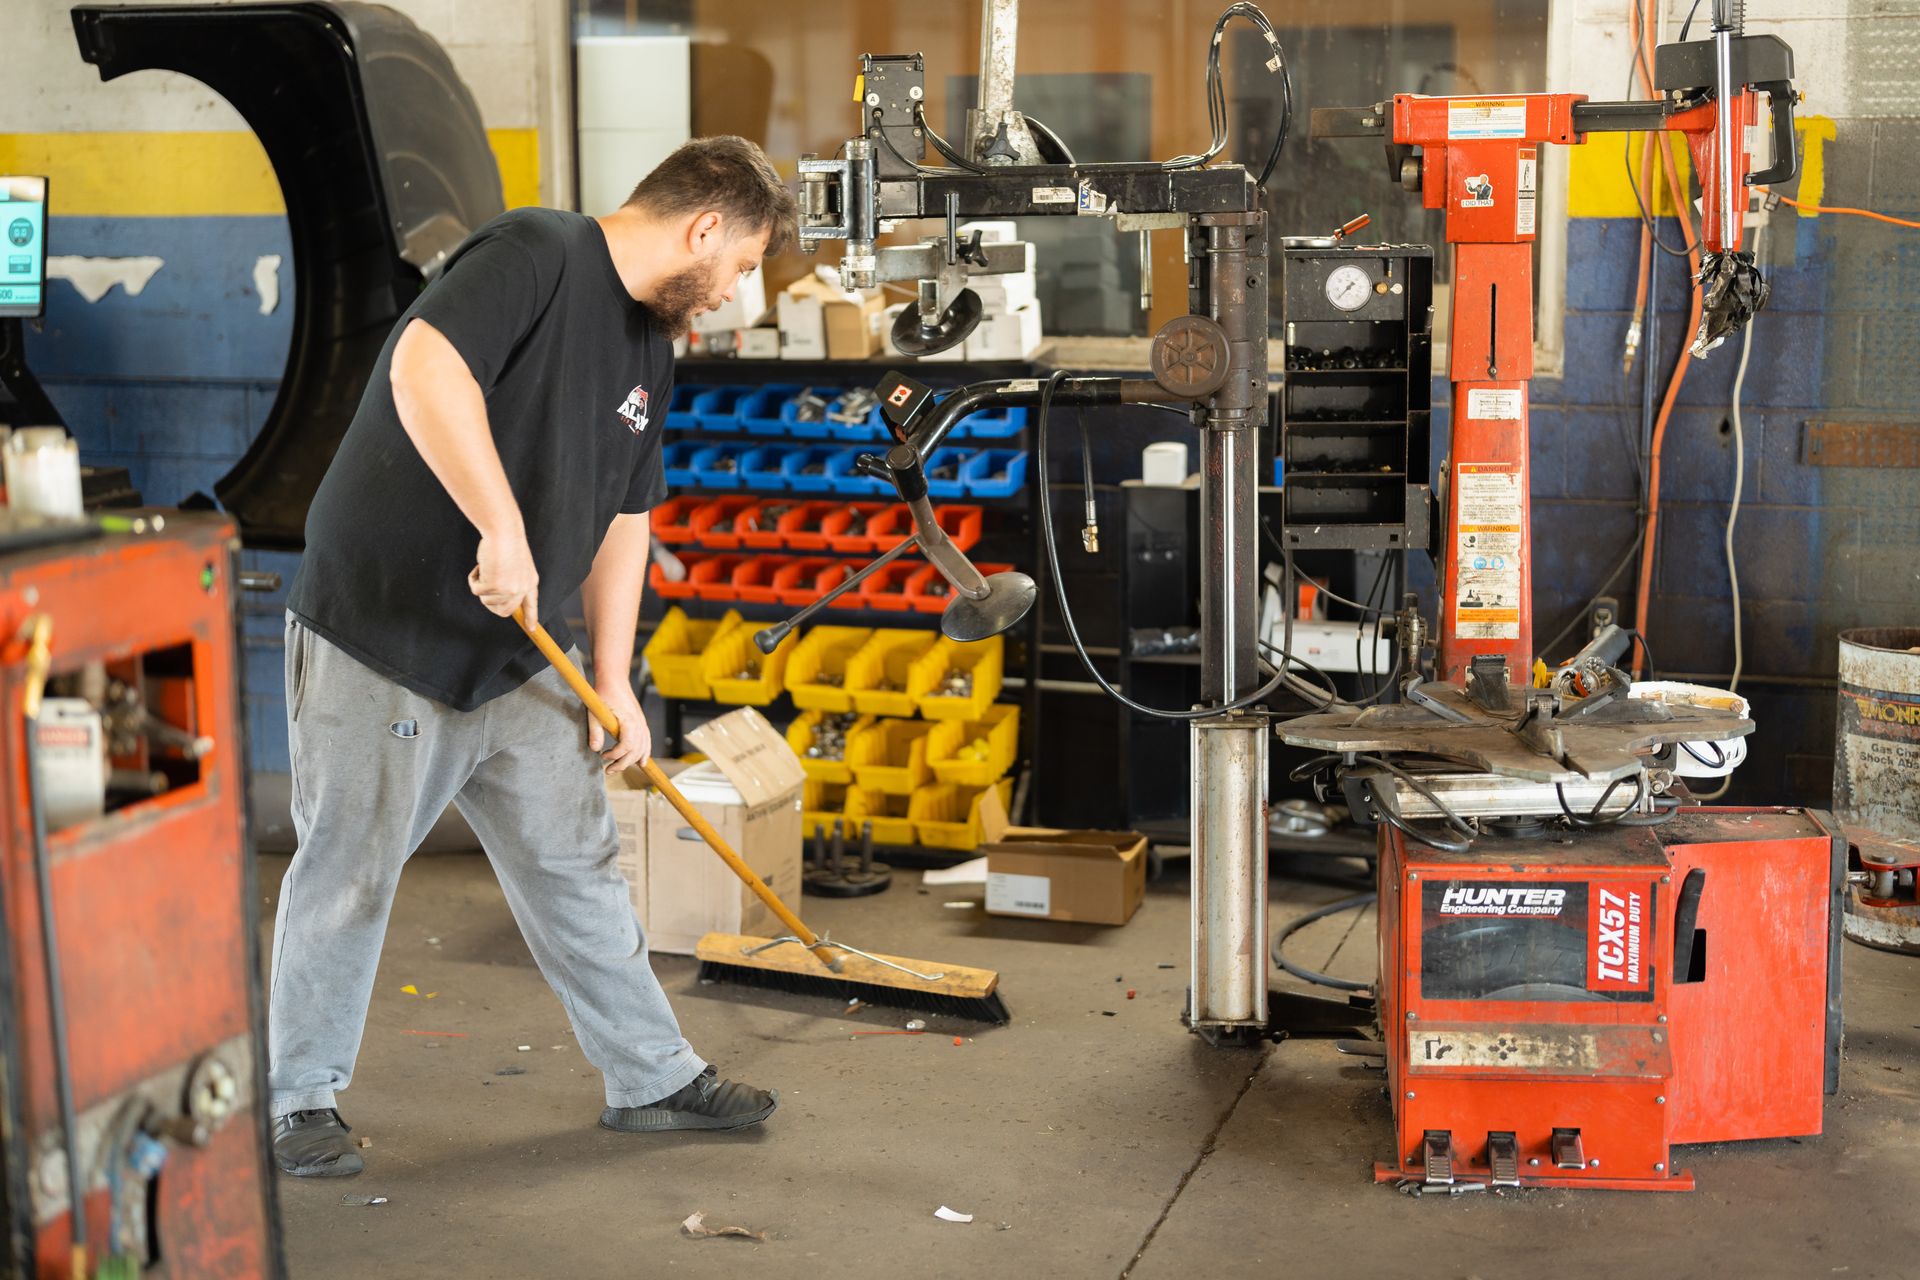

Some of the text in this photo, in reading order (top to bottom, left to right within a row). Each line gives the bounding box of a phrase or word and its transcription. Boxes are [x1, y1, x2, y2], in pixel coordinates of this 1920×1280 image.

[1871, 743, 1892, 754] Gas
[1860, 751, 1894, 766] Shock
[1442, 888, 1566, 905] HUNTER
[1440, 904, 1562, 915] Engineering Company
[1598, 888, 1625, 980] TCX57
[1627, 891, 1641, 983] MAXIMUM DUTY
